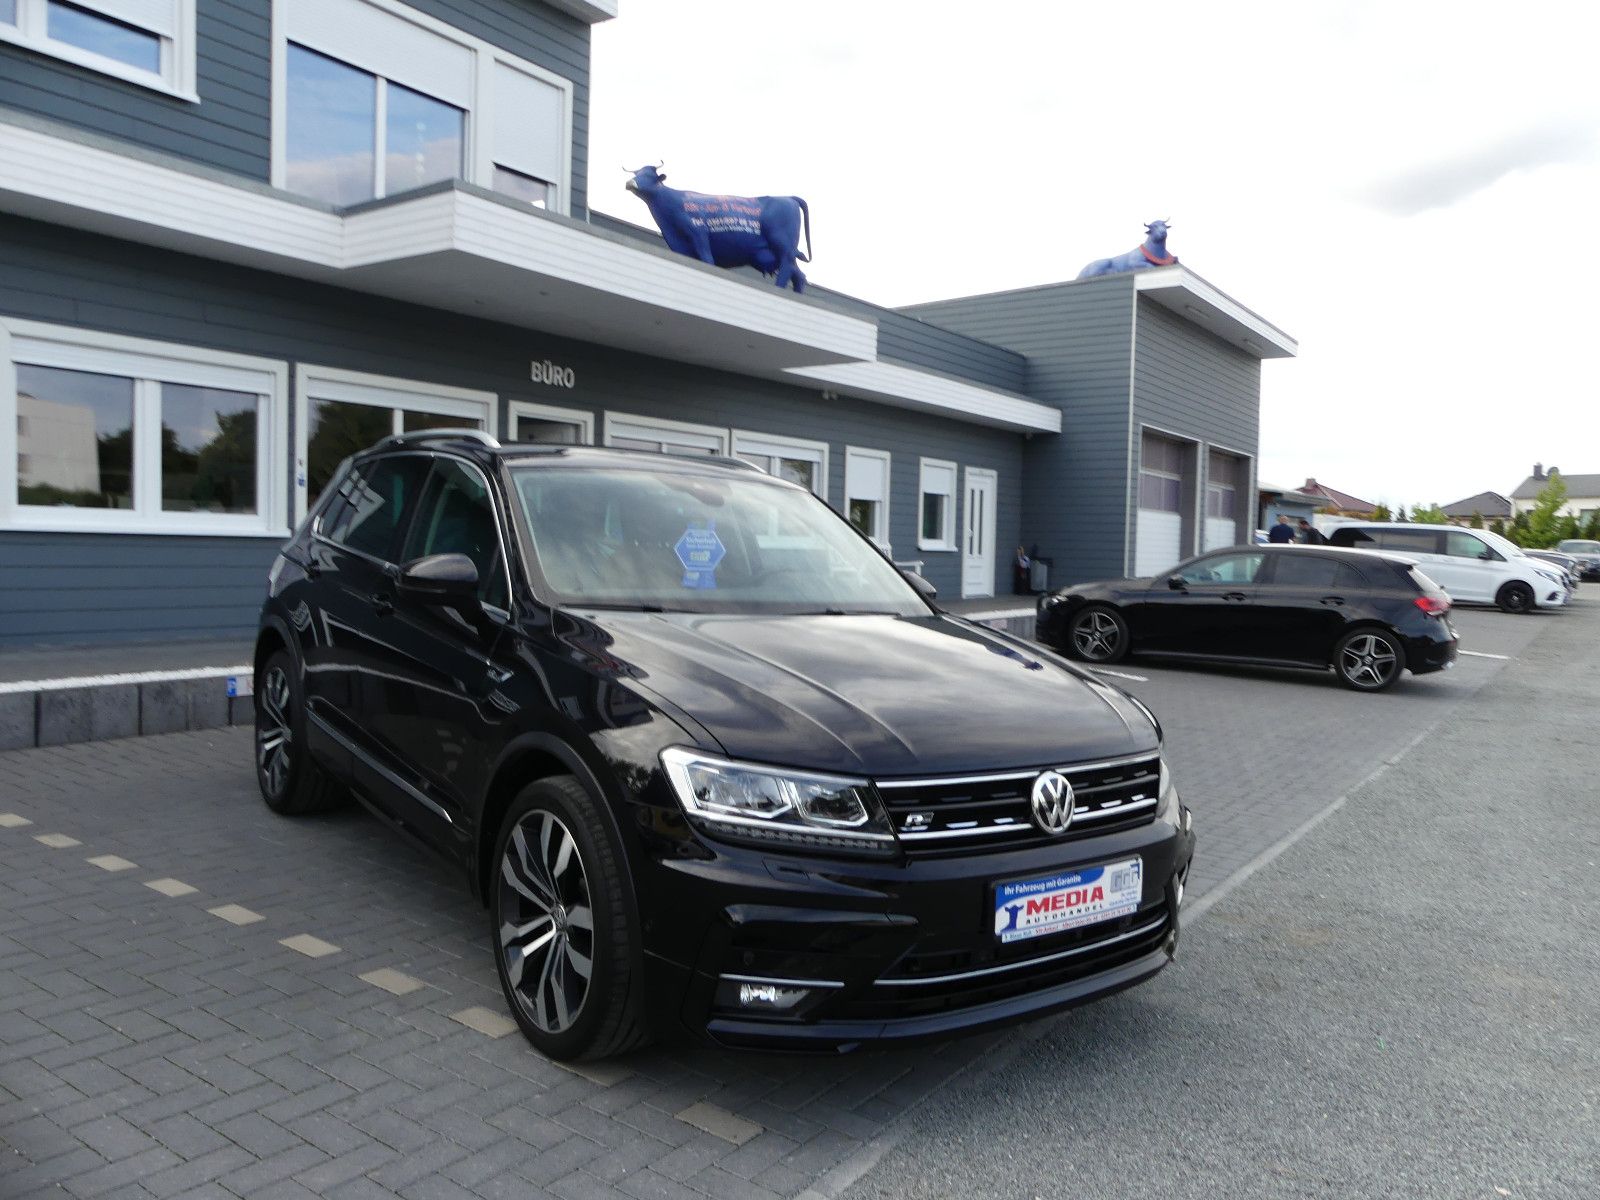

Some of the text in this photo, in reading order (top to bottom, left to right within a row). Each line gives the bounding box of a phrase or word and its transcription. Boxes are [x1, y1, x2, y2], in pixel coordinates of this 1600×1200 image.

[531, 360, 575, 389] BÜRO
[1004, 874, 1082, 896] Ihr Fahrzeug mit Garantie
[1026, 886, 1104, 916] MEDIA
